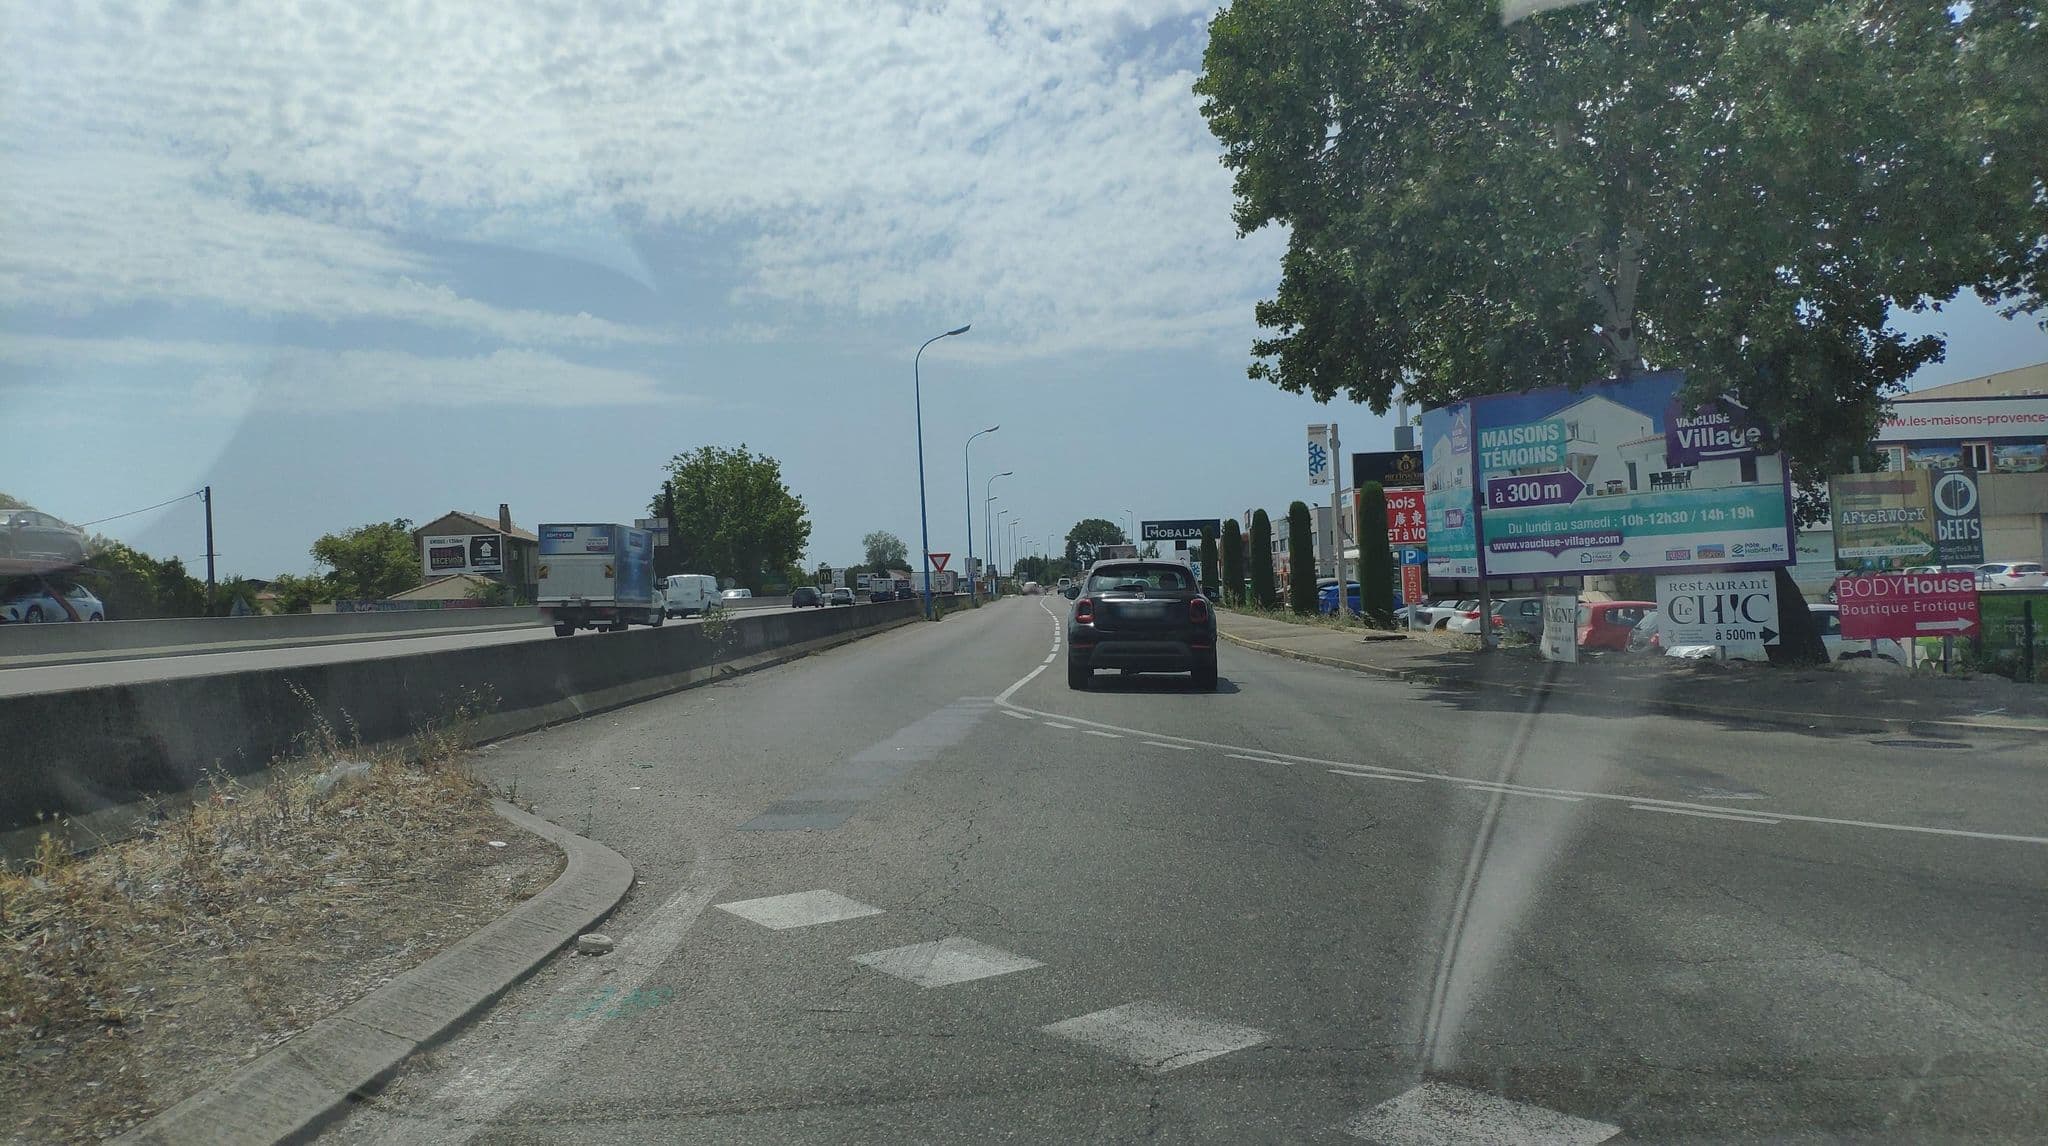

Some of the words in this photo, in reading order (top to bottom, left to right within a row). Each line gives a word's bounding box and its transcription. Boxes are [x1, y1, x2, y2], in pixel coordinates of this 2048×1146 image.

[1481, 424, 1560, 448] MAISONS
[1676, 427, 1761, 449] Village
[1481, 445, 1558, 468] TÉMOINS
[1495, 488, 1504, 503] à
[1507, 482, 1540, 502] 300
[1544, 483, 1561, 499] m
[1508, 522, 1522, 534] Du
[1525, 519, 1551, 533] lundi
[1554, 519, 1567, 531] au
[1570, 516, 1610, 529] samedi
[1620, 510, 1688, 527] 10h-12h30
[1150, 527, 1203, 538] MOBALPA
[1403, 528, 1409, 541] à
[1492, 534, 1620, 551] www.vaucluse-village.com
[1405, 550, 1416, 563] P
[1841, 603, 1909, 616] Boutique
[1914, 599, 1976, 613] Erotique
[1715, 629, 1722, 641] à
[1725, 629, 1756, 641] 500m
